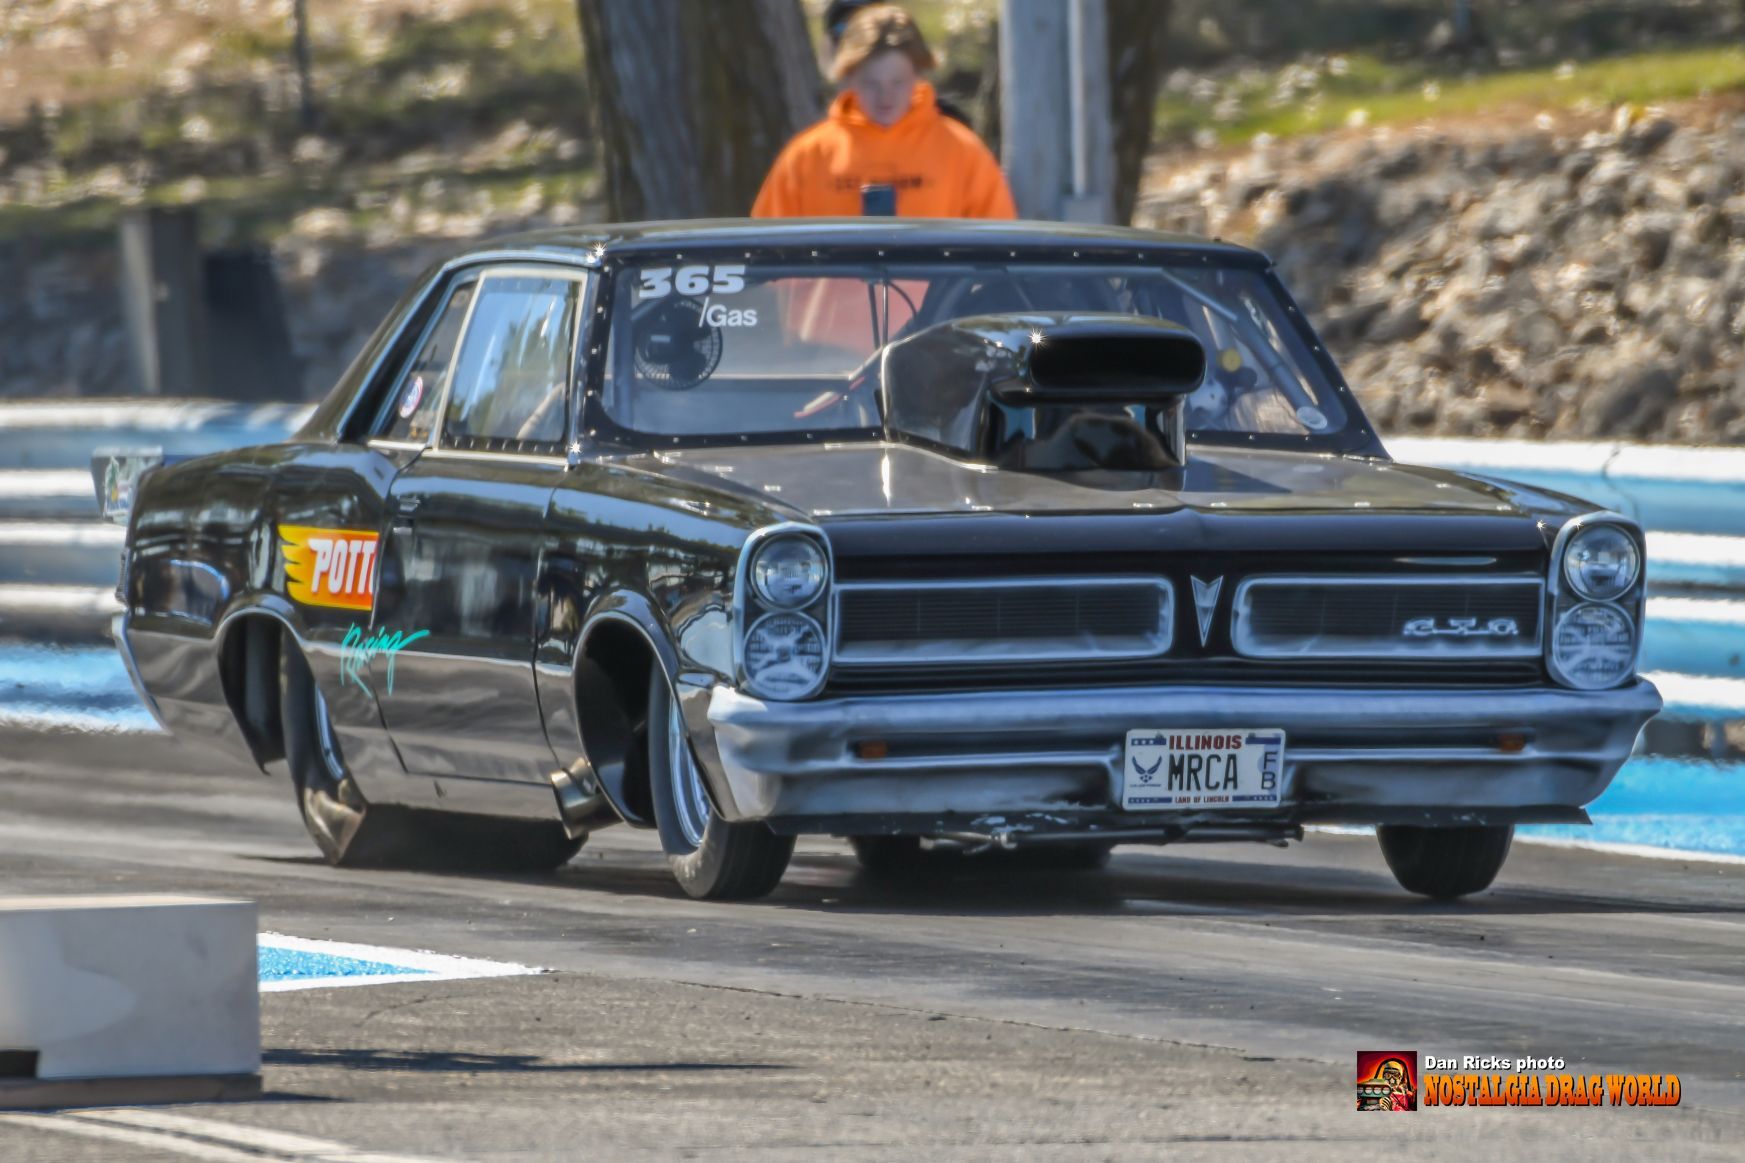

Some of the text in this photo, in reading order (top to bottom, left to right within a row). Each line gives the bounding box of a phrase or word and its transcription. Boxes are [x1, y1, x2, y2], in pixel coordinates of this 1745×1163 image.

[639, 264, 746, 298] 365
[699, 297, 758, 328] /Gas
[340, 622, 431, 698] Racing
[1168, 735, 1242, 750] ILLINOIS
[1167, 753, 1238, 791] MRCA
[1174, 795, 1230, 804] LAND OF LINCOLN
